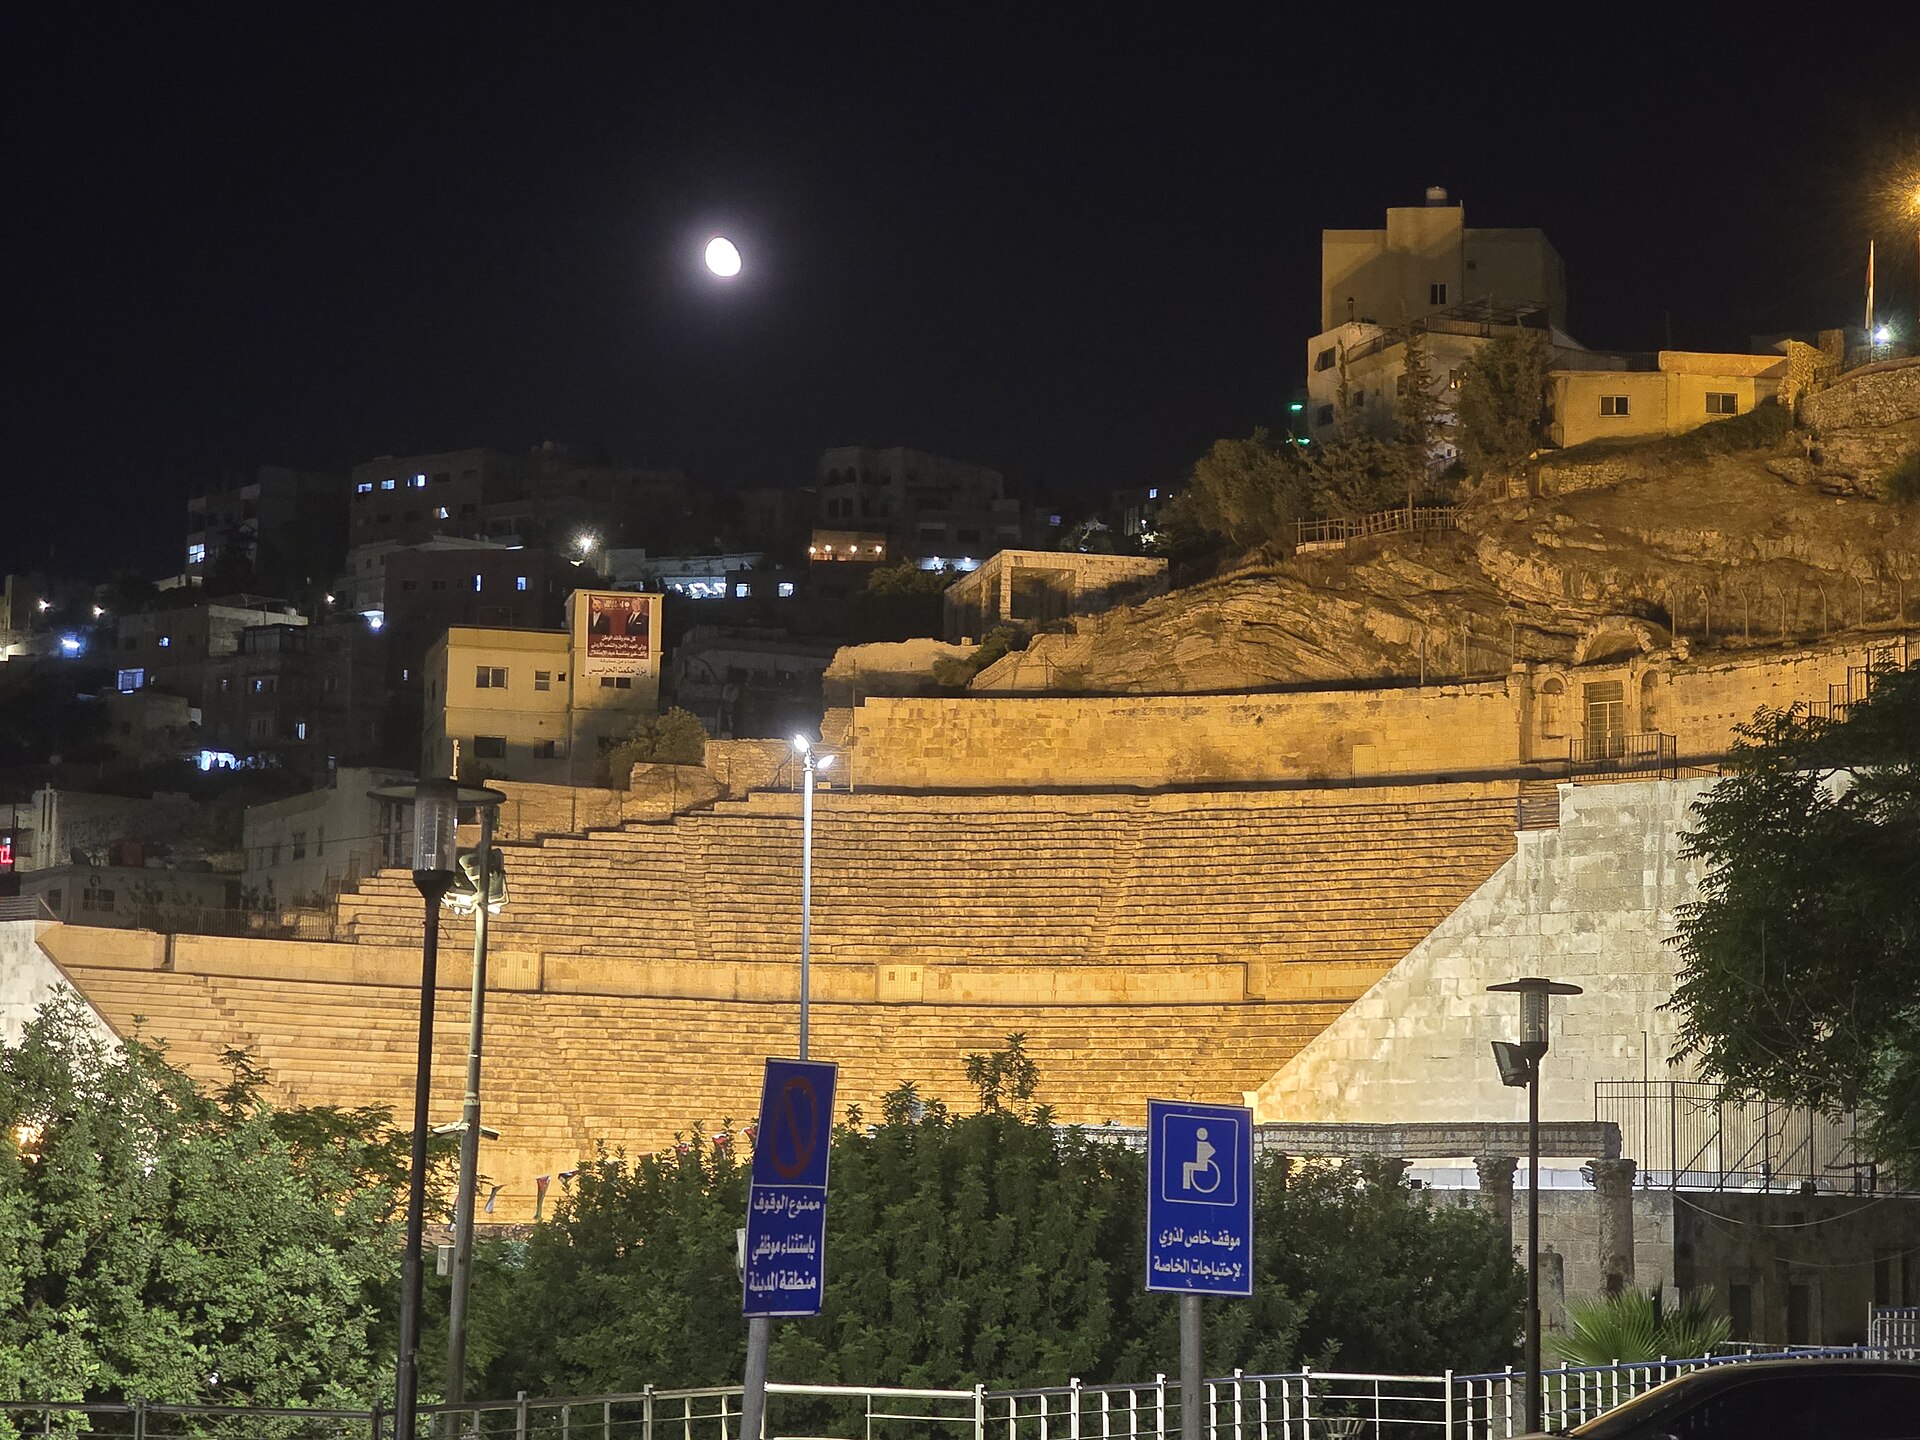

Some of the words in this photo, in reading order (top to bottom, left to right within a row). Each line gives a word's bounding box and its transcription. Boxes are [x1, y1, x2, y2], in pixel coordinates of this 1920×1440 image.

[753, 1192, 789, 1215] الوقوف
[787, 1195, 821, 1219] ممنوع
[1158, 1226, 1184, 1248] لذوي
[1184, 1229, 1211, 1248] خاص
[1211, 1229, 1241, 1252] موقف
[751, 1233, 781, 1266] موظفي
[1153, 1255, 1190, 1273] الخاصة
[748, 1270, 779, 1298] المدينة
[779, 1269, 817, 1291] منطقة
